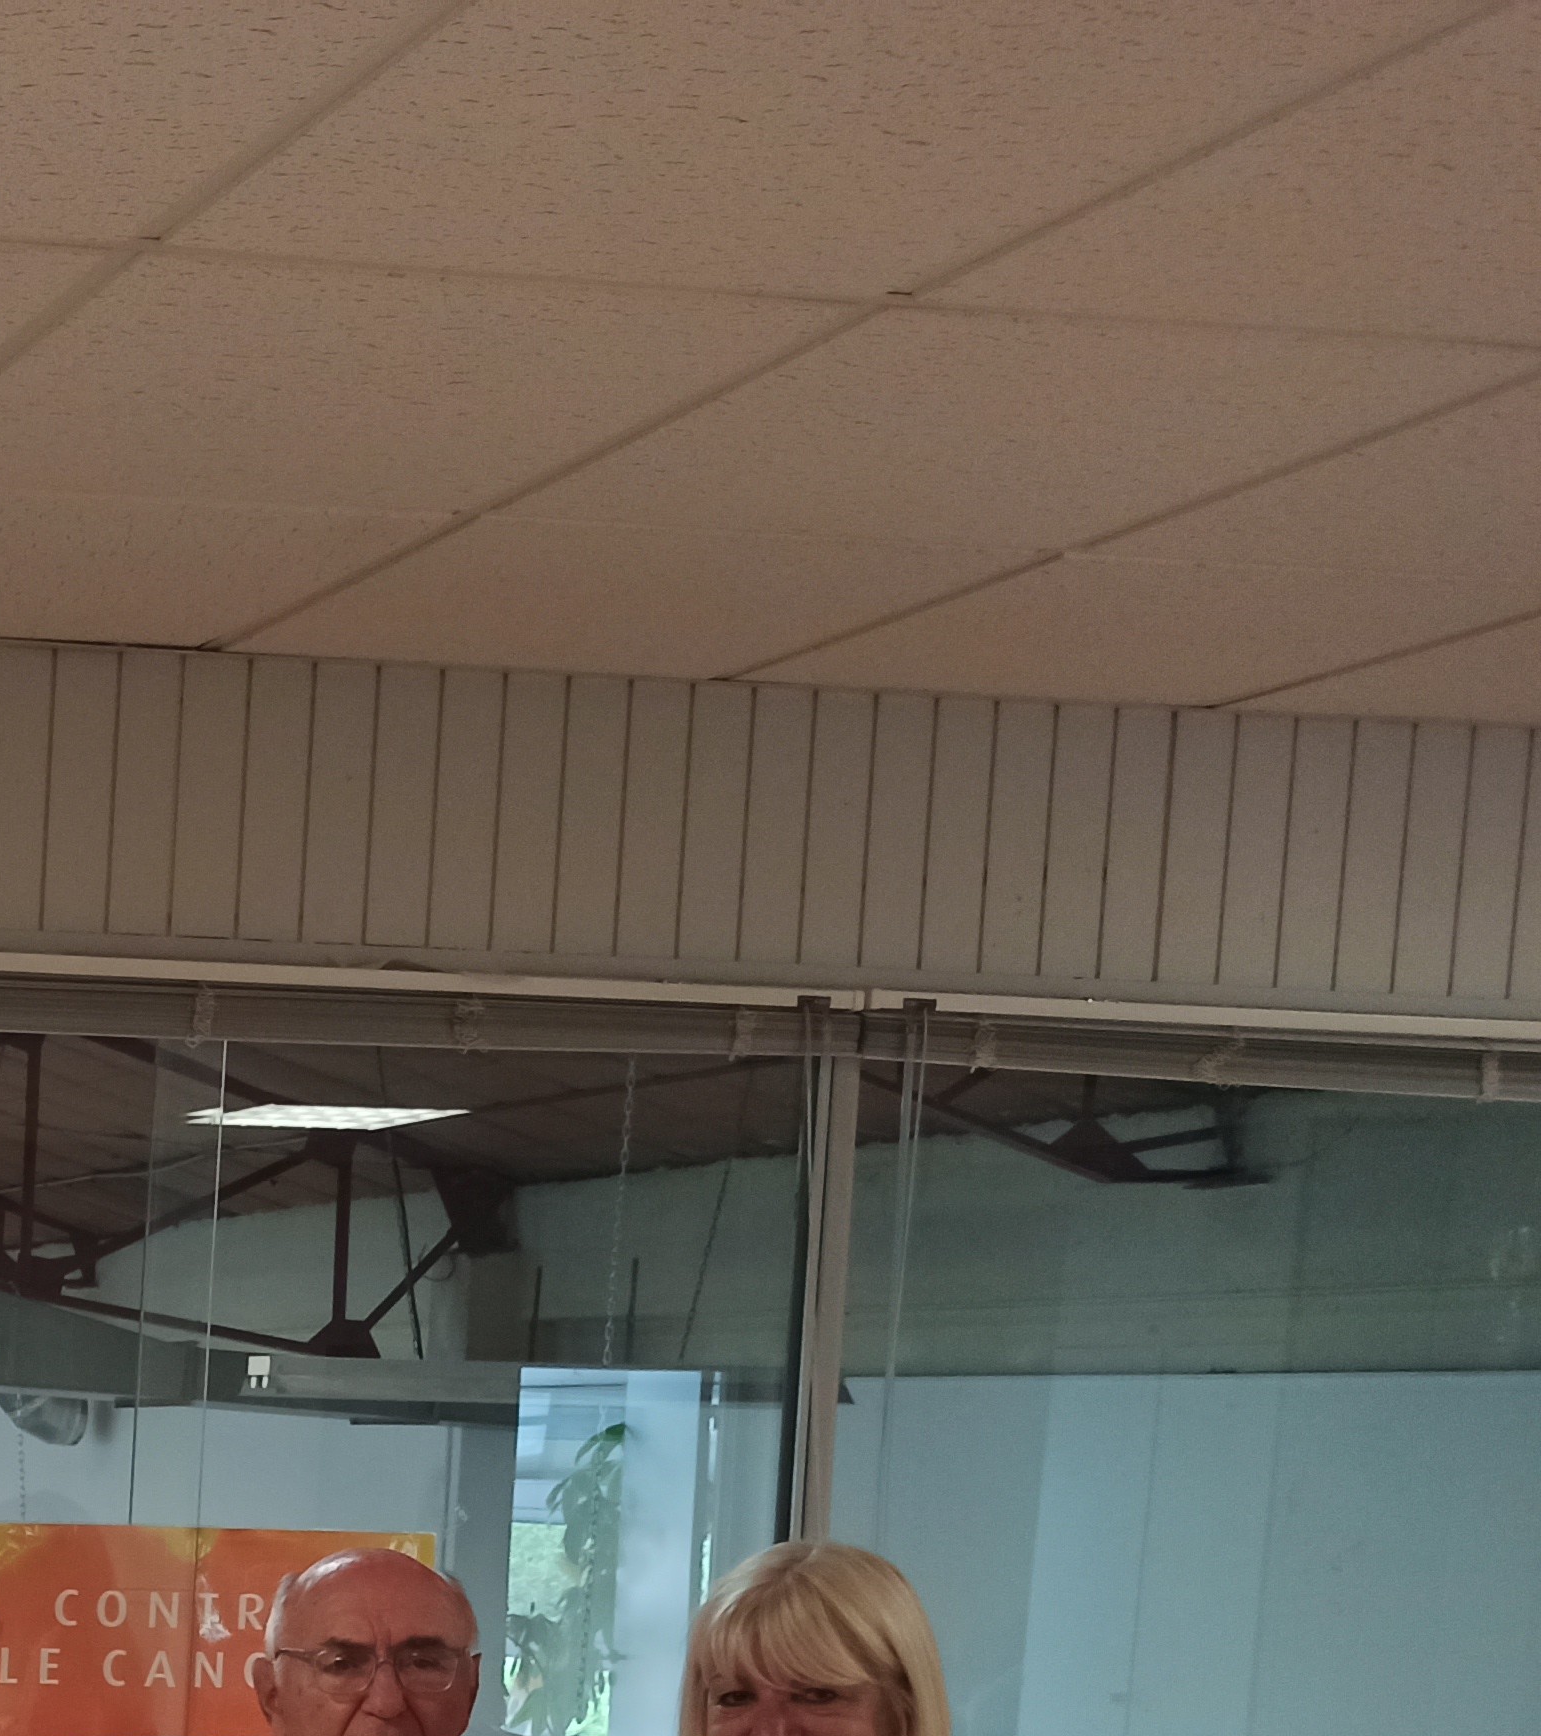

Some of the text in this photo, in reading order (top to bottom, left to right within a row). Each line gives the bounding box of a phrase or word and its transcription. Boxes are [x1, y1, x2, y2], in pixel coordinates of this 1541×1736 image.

[54, 1588, 266, 1632] CONTR
[0, 1646, 267, 1689] LE CANC
